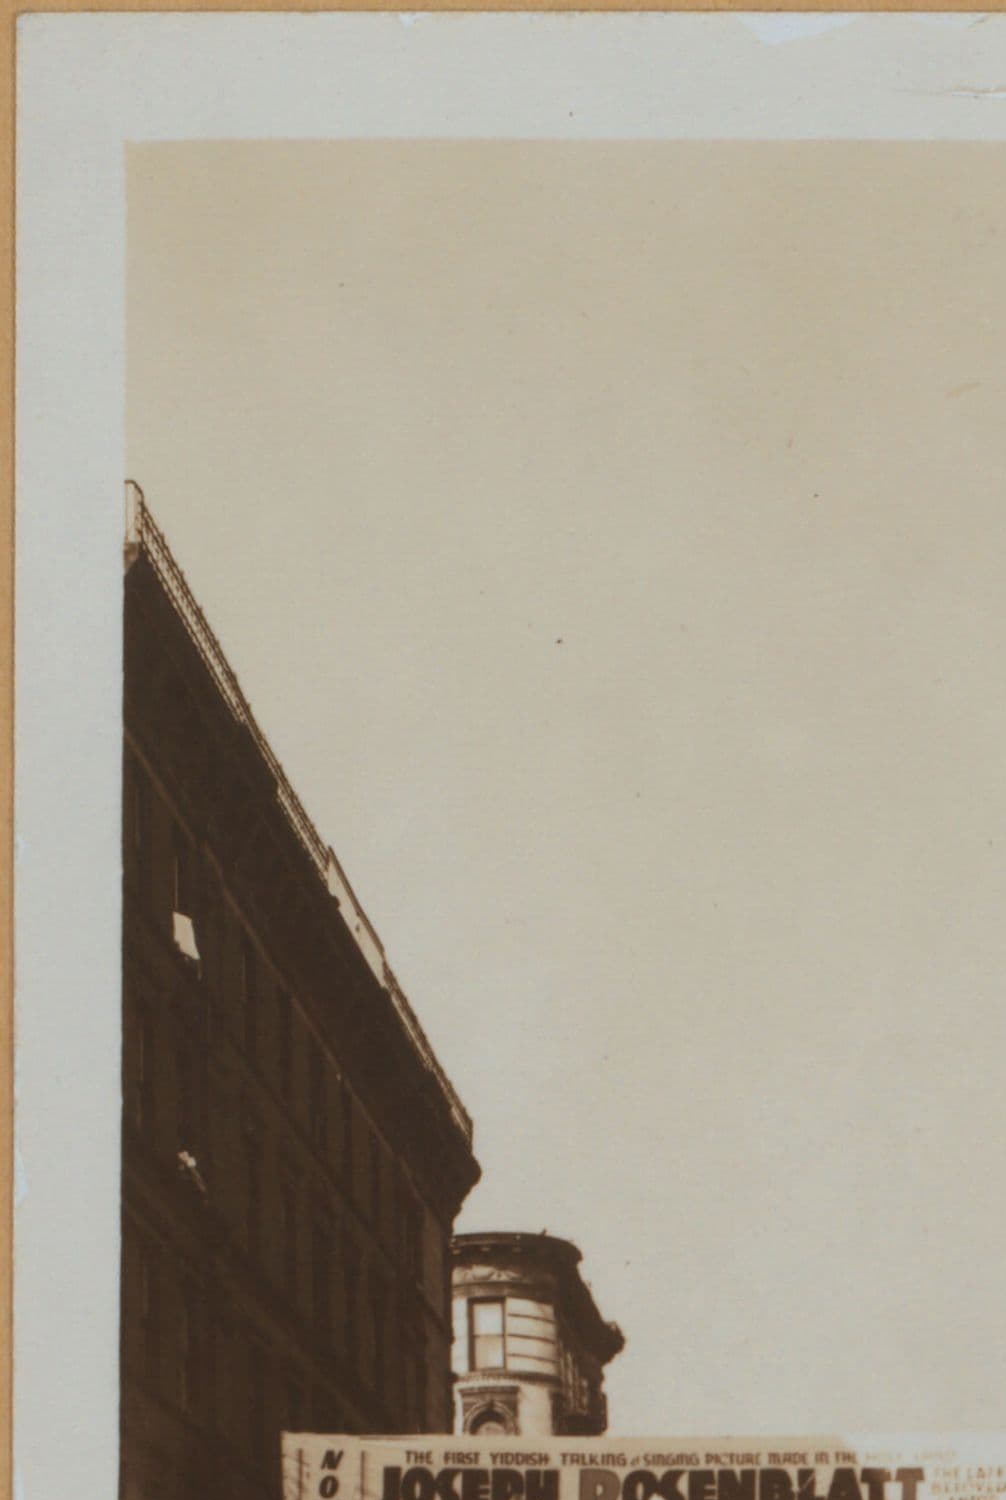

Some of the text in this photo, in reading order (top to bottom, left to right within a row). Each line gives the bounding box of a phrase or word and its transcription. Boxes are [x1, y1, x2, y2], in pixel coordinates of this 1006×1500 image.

[405, 1450, 433, 1465] THE
[443, 1451, 481, 1465] FIRST
[490, 1451, 550, 1466] YIDDISH
[560, 1452, 627, 1467] TALKING
[643, 1452, 700, 1467] SINGING
[704, 1451, 761, 1466] PICTURE
[768, 1451, 808, 1465] MADE
[815, 1451, 829, 1464] IN
